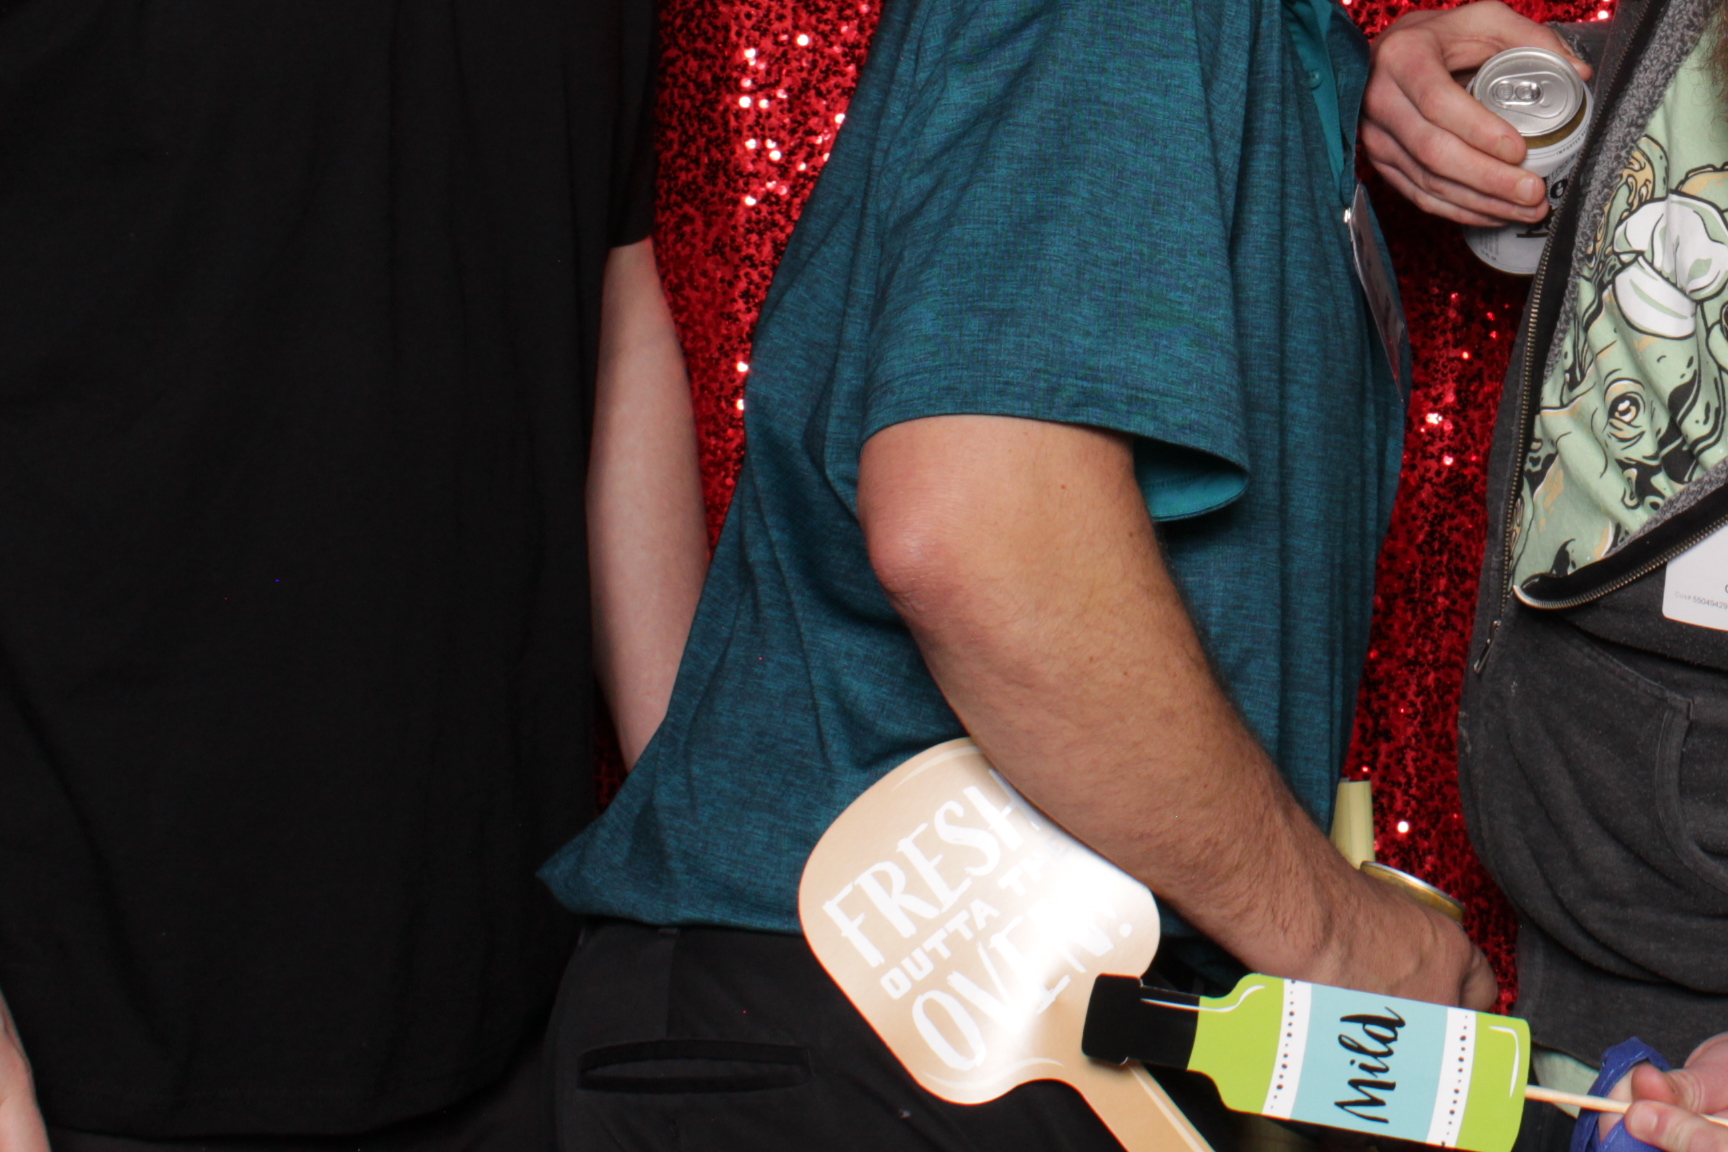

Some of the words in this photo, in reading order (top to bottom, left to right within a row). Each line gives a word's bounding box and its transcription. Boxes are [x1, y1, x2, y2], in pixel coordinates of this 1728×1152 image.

[1692, 595, 1728, 610] 55049429
[880, 898, 1001, 999] OUTTA
[1333, 1006, 1406, 1124] Mild
